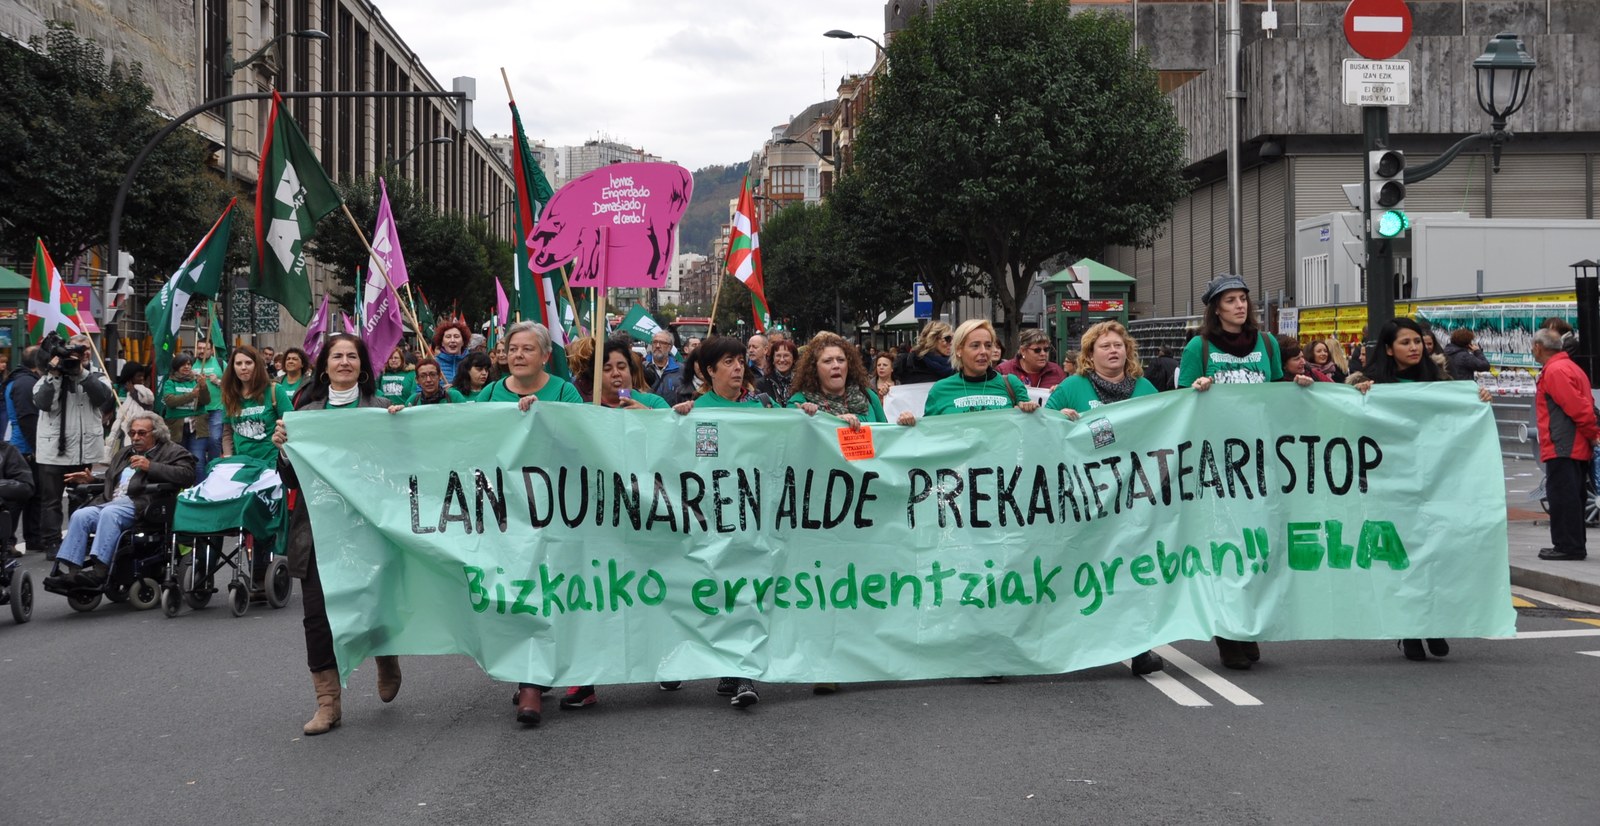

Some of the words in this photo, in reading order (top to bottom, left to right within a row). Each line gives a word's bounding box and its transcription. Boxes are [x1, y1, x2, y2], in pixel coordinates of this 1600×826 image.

[1379, 72, 1393, 80] EZIK
[609, 173, 635, 189] hemos
[601, 185, 651, 201] Engordado
[592, 198, 642, 216] Demasiado
[613, 211, 621, 225] el
[408, 466, 508, 535] LAN
[521, 465, 762, 534] DUINAREN
[774, 465, 880, 532] ALDE
[906, 438, 1268, 530] PREKARIETATEARI
[1274, 434, 1384, 497] STOP
[463, 558, 668, 618] Bizkaiko
[690, 555, 1063, 617] erresidentziak
[1073, 526, 1270, 616] greban!!
[1287, 519, 1410, 571] ELA
